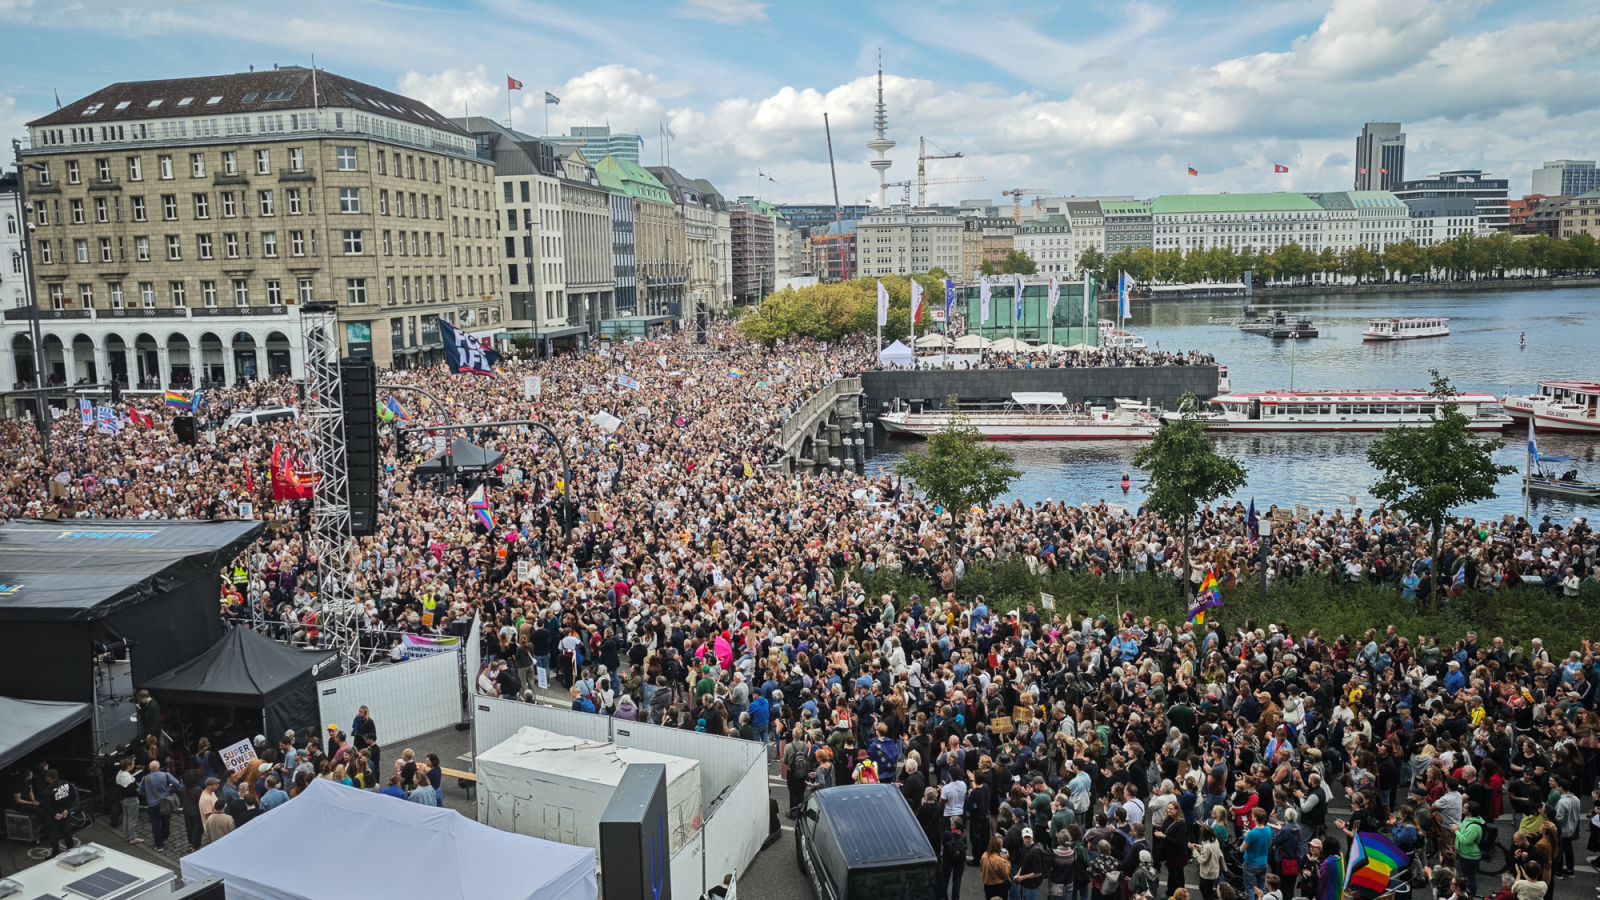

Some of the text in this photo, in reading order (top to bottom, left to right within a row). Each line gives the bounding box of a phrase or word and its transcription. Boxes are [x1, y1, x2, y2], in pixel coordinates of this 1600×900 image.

[1546, 410, 1569, 418] GOLDBEK
[223, 744, 251, 761] SUPER
[225, 750, 255, 768] POWER
